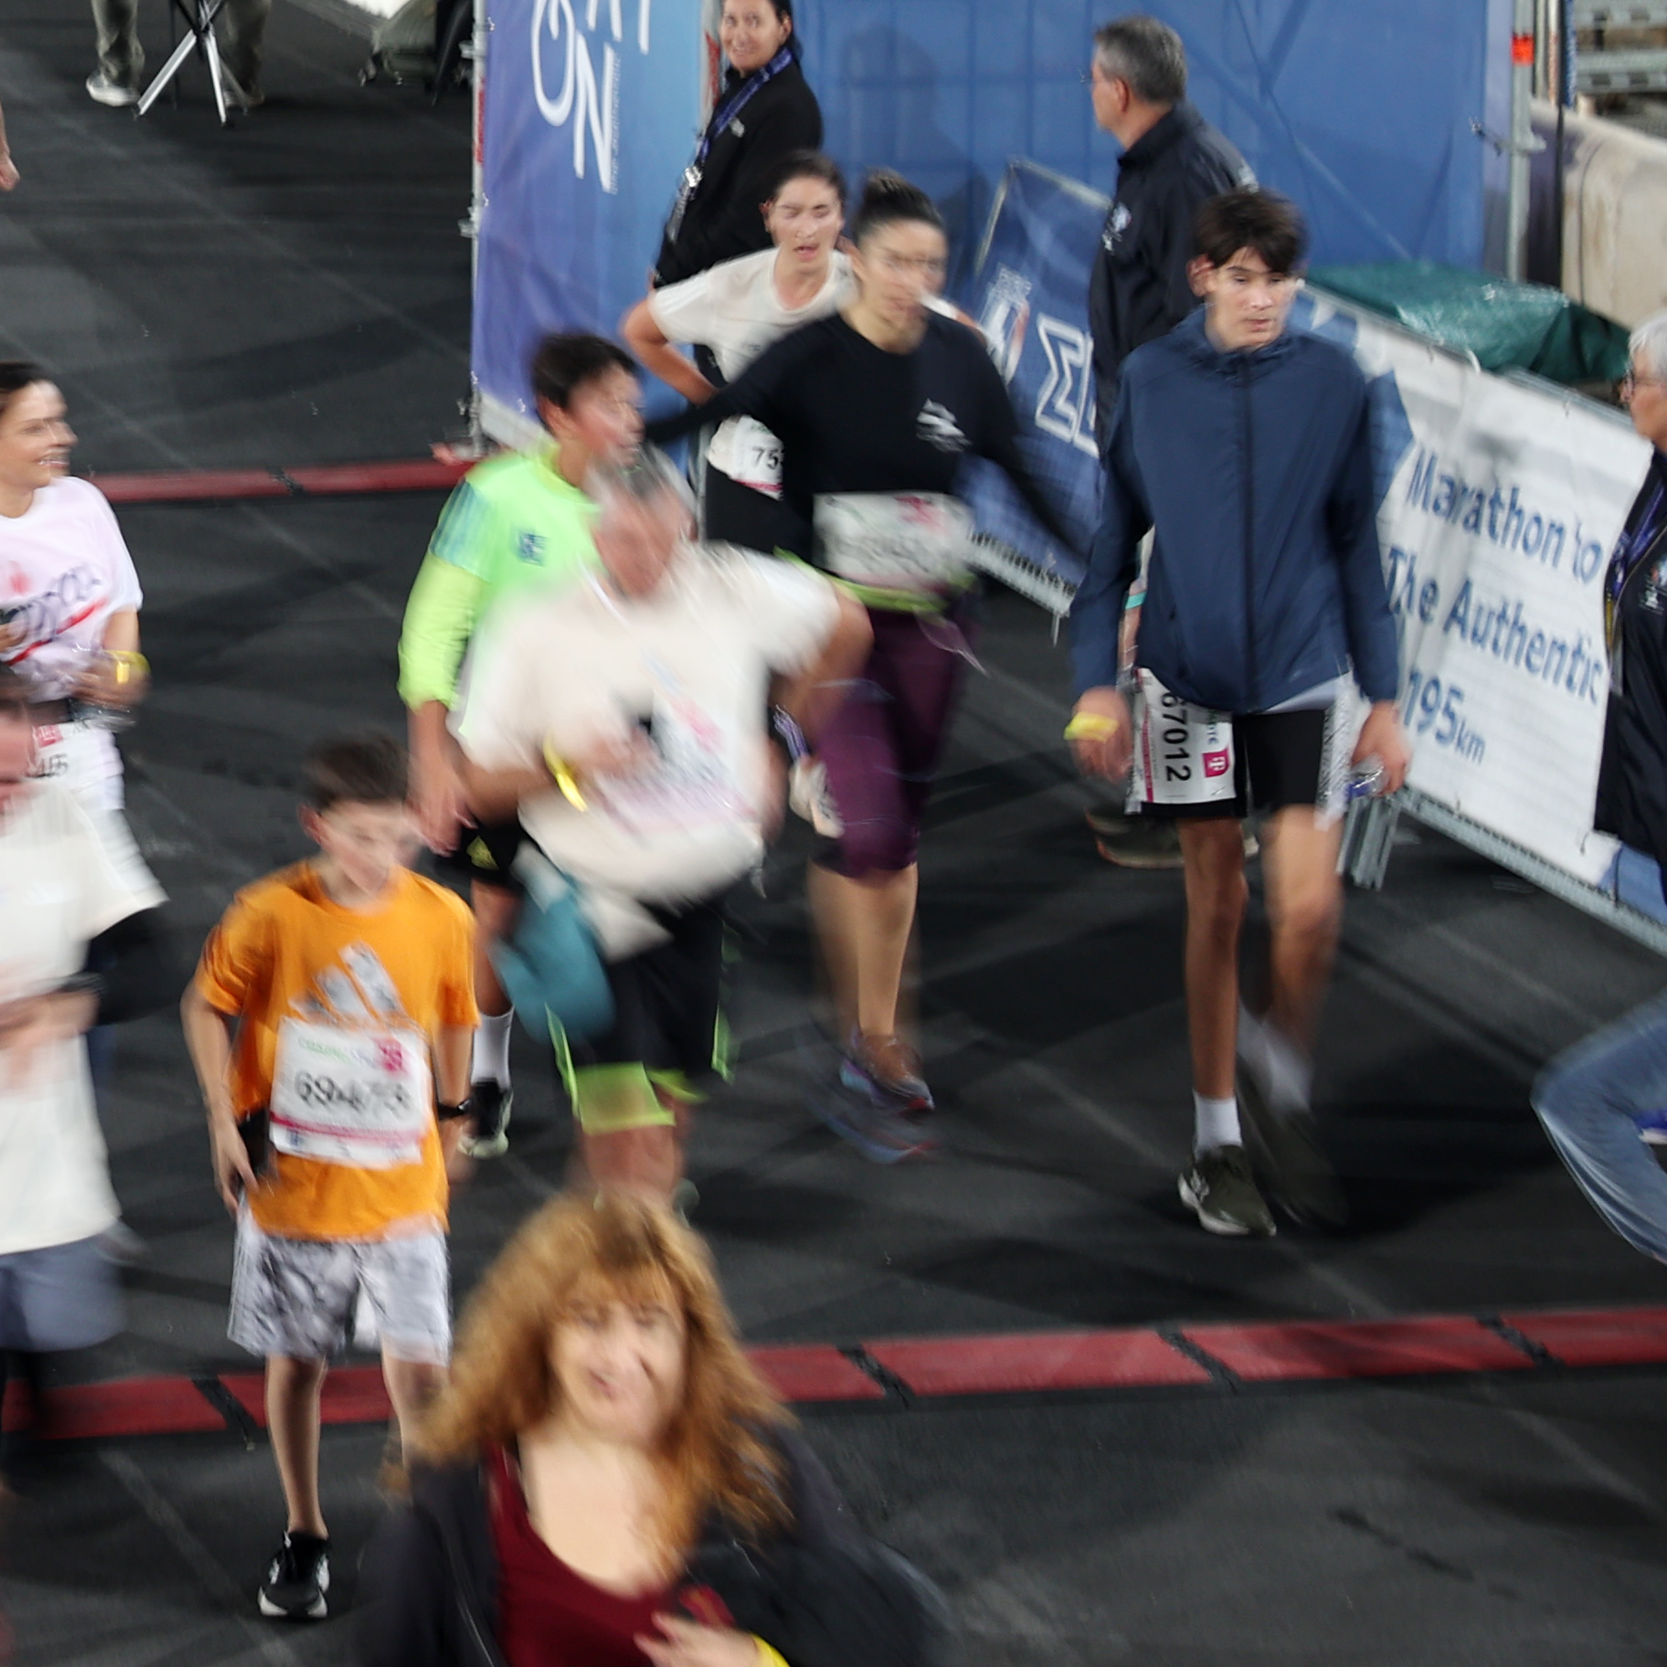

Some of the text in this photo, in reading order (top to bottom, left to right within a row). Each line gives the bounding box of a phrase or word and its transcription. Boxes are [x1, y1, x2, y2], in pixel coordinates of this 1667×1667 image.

[1406, 447, 1566, 570] Marathon
[1388, 545, 1605, 707] The Authentic
[1160, 692, 1192, 783] 67012
